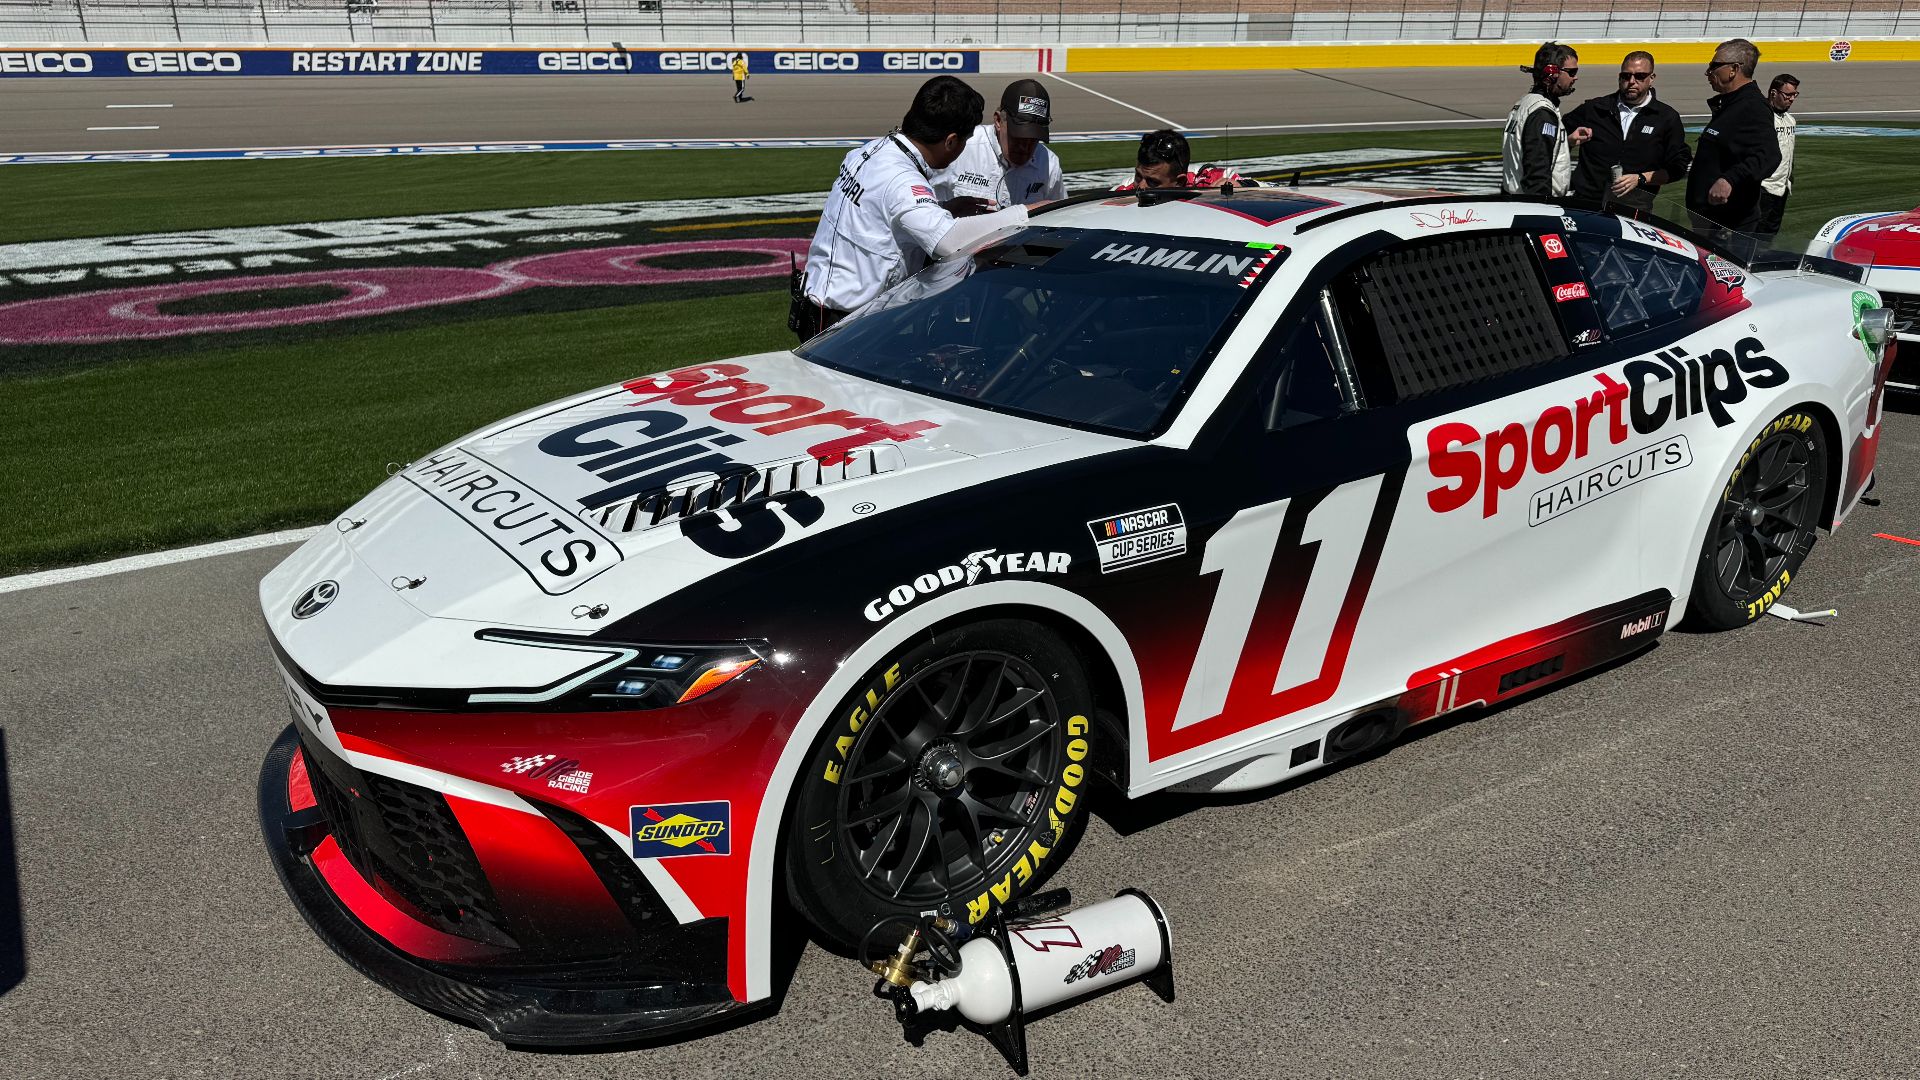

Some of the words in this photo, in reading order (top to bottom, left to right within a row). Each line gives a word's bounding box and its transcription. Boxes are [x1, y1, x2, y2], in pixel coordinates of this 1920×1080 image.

[0, 52, 93, 73] EICO
[126, 52, 242, 73] GEICO
[291, 52, 408, 72] RESTART
[416, 52, 483, 72] ZONE
[537, 52, 633, 71] GEICO
[659, 52, 749, 71] GEICO
[773, 52, 859, 70] GEICO
[882, 52, 964, 70] GEICO
[957, 174, 990, 187] OFFICIAL
[1623, 219, 1689, 252] FedEx
[1090, 242, 1252, 277] HAMLIN
[622, 363, 940, 467] Sport
[537, 409, 826, 559] Clips
[1536, 441, 1684, 520] HAIRCUTS
[420, 453, 597, 577] HAIRCUTS
[1119, 509, 1169, 533] NASCAR
[1111, 543, 1134, 560] CUP
[1136, 532, 1175, 554] SERIES
[864, 547, 1072, 623] GOODYEAR
[1747, 568, 1791, 620] EAGLE
[1169, 472, 1386, 733] 11
[1619, 615, 1652, 640] Mobil
[823, 662, 901, 785] EAGLE
[547, 780, 589, 794] RACING
[557, 774, 591, 787] GIBBS
[570, 770, 594, 780] JOE
[640, 819, 724, 843] SUNOCO
[967, 715, 1089, 924] GOODYEAR
[1105, 961, 1135, 976] RACING
